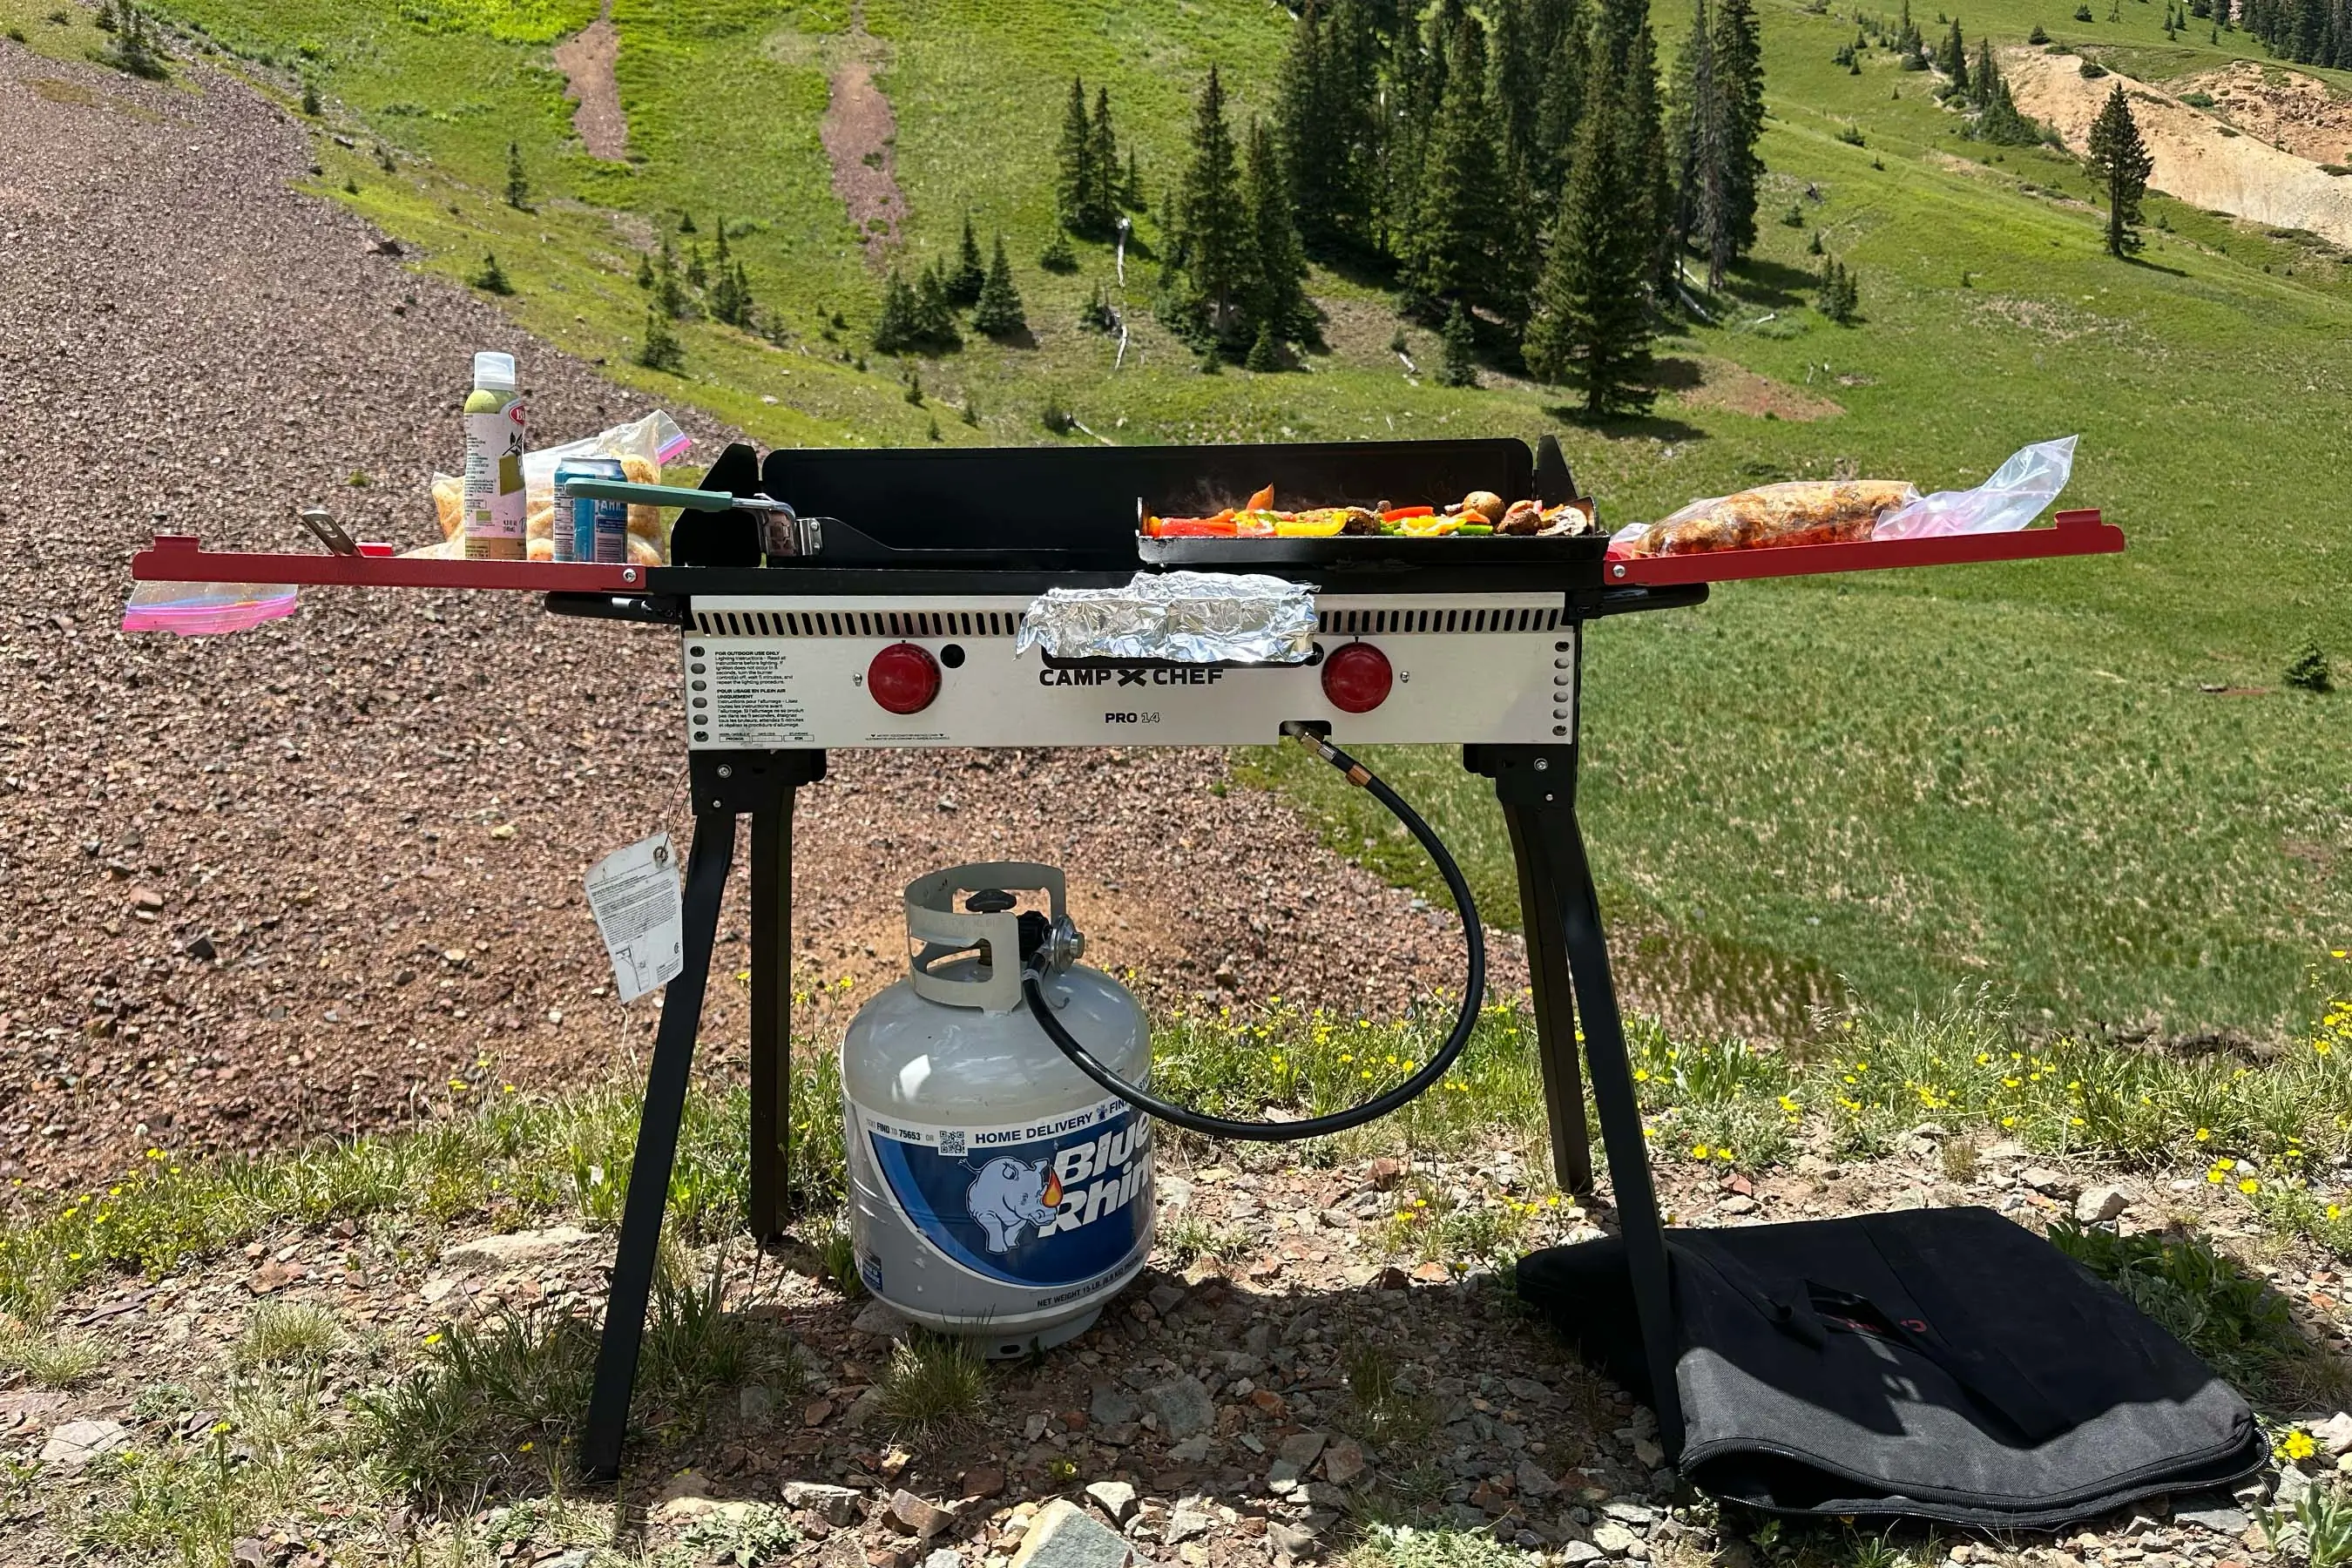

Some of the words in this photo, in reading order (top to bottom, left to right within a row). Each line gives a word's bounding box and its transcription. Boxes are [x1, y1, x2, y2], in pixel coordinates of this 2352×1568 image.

[1039, 669, 1112, 686] CAMP
[1152, 668, 1224, 685] CHEF
[1105, 713, 1138, 724] PRO
[1141, 712, 1160, 723] 14
[876, 1122, 890, 1134] FIND
[898, 1129, 921, 1141] 75653
[975, 1129, 1021, 1144] HOME
[1026, 1112, 1093, 1139] DELIVERY
[1109, 1098, 1127, 1114] FIN
[1053, 1111, 1151, 1187] Blue
[1037, 1151, 1153, 1238] Rhin
[1037, 1297, 1052, 1308] NET
[1053, 1289, 1081, 1304] WEIGHT
[1083, 1285, 1091, 1294] 15
